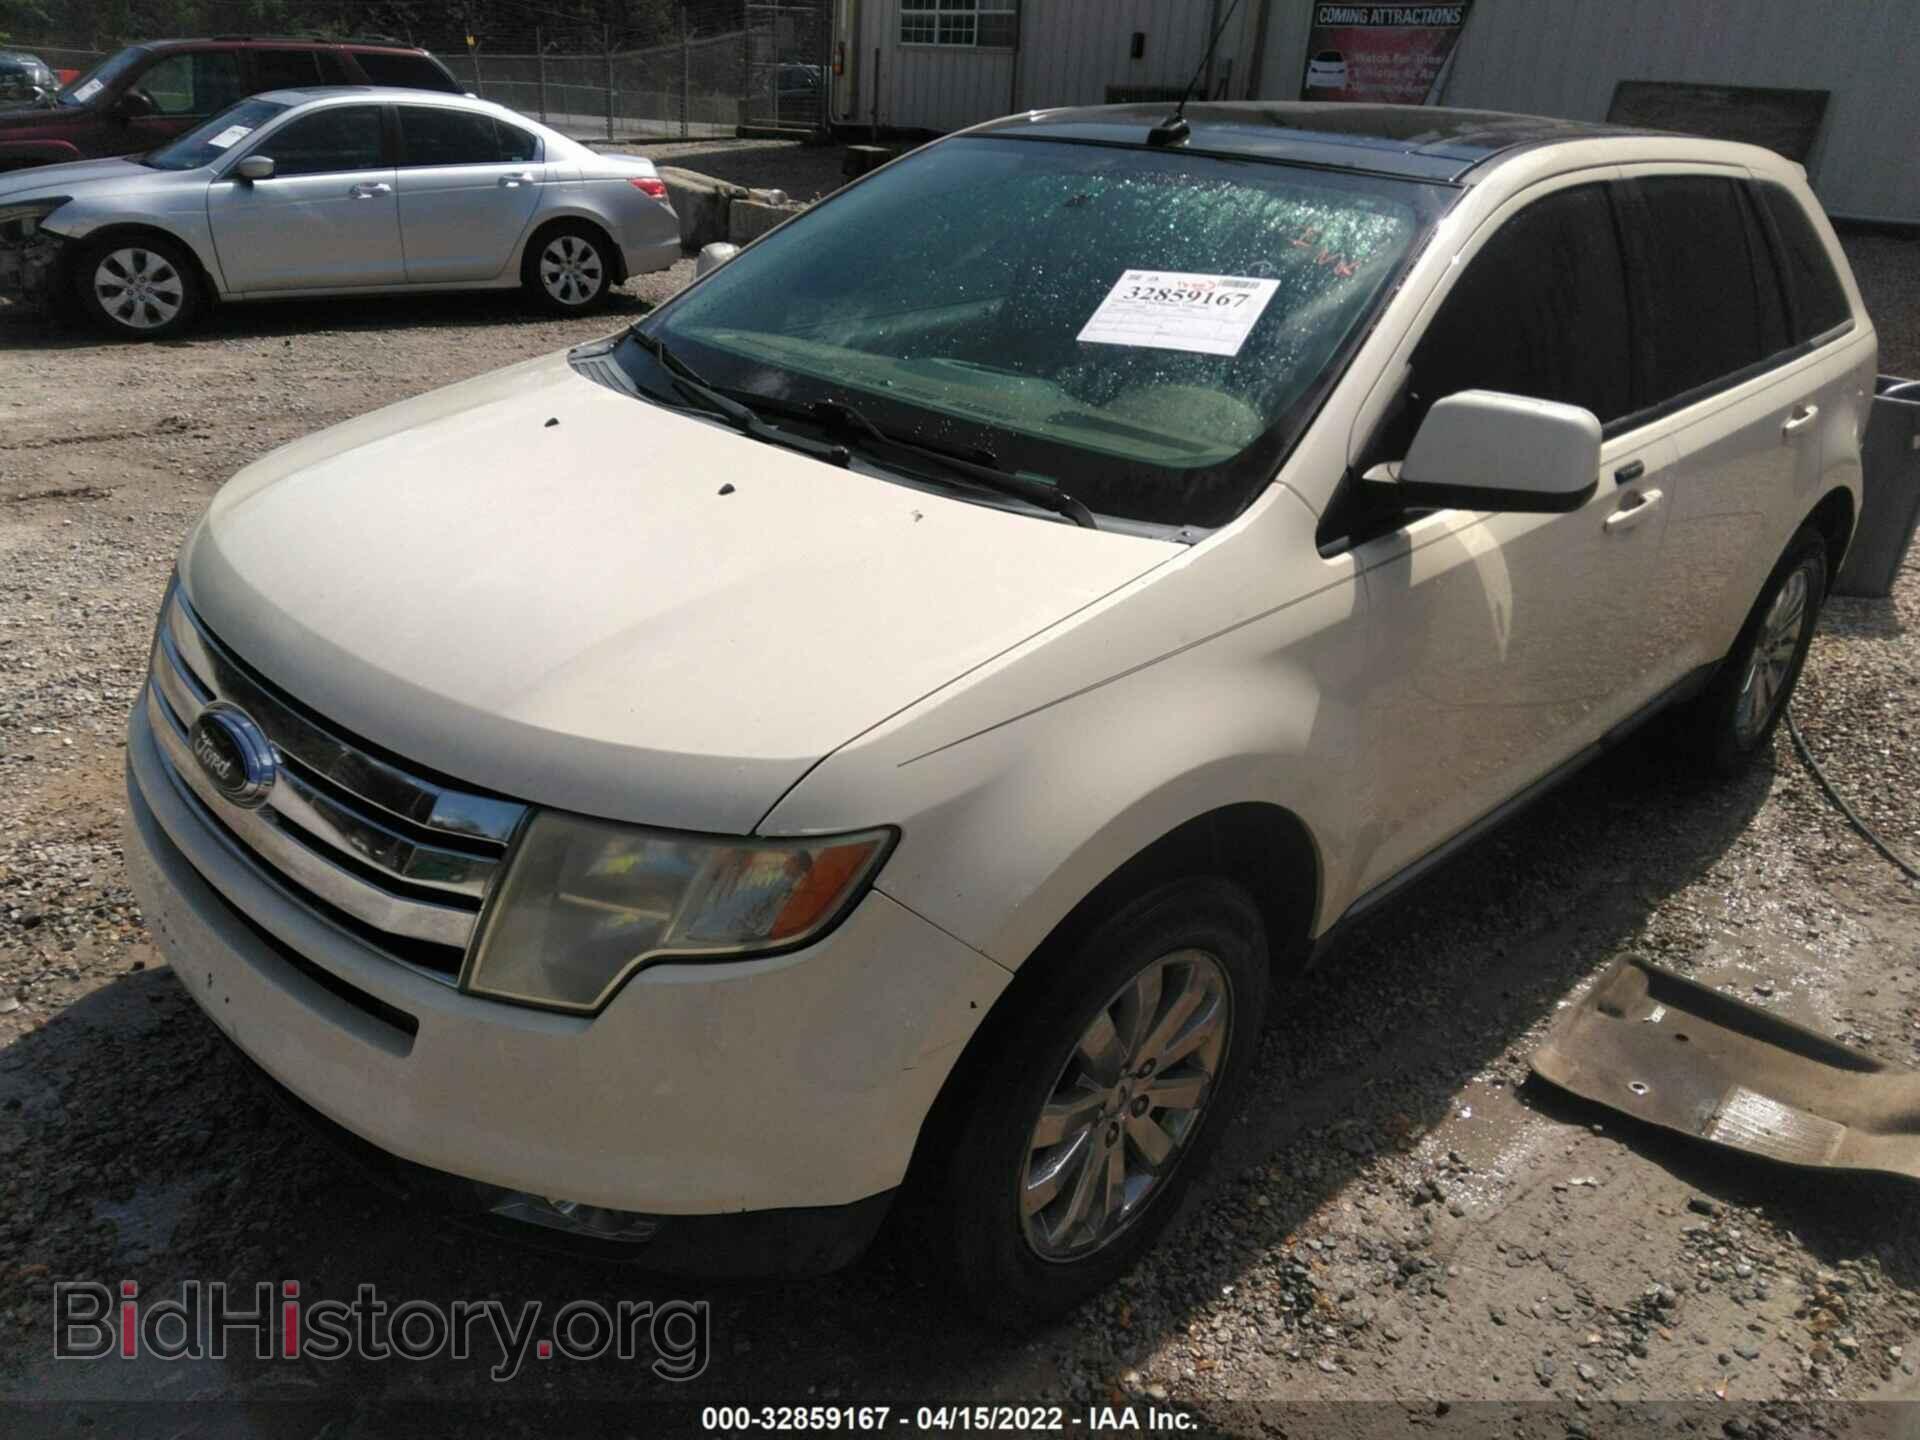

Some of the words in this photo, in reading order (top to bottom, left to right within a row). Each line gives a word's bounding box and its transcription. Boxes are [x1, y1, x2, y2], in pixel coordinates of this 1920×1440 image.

[1319, 7, 1368, 24] COMING
[1370, 7, 1461, 24] ATTRACTIONS
[1123, 286, 1250, 308] 32859167
